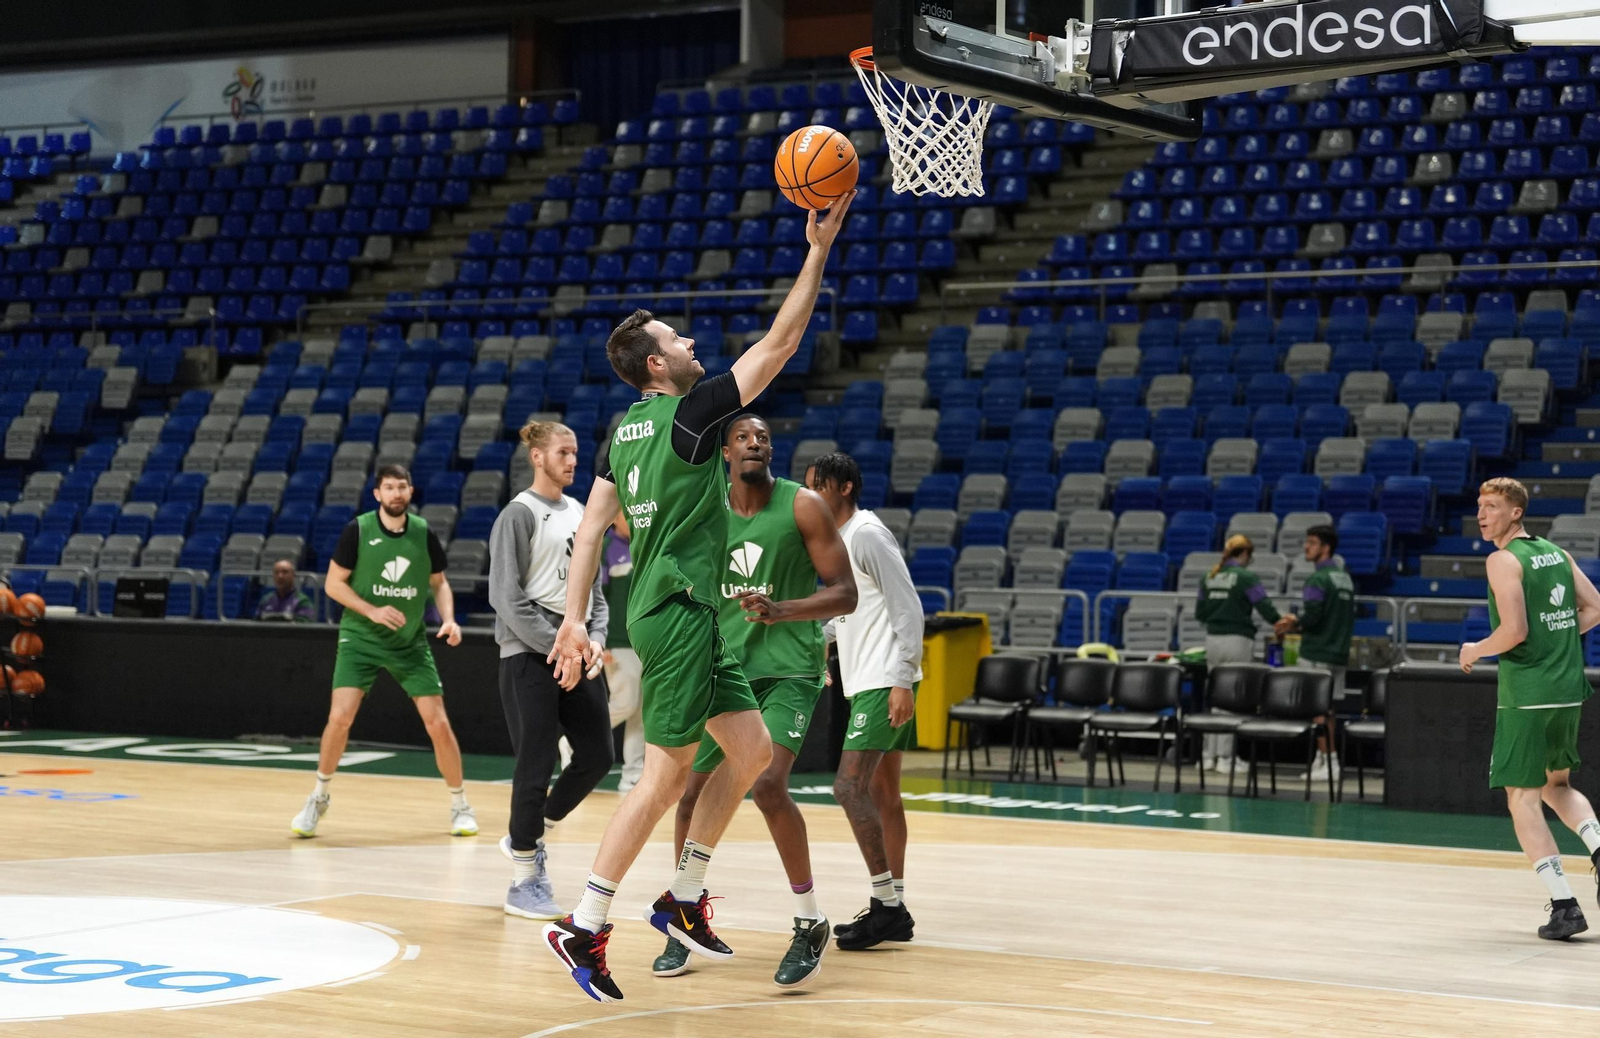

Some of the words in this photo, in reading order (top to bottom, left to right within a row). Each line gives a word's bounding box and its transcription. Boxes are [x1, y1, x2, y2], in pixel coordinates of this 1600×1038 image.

[919, 2, 953, 20] endesa
[1182, 4, 1431, 66] endesa
[372, 584, 418, 601] Unicaja
